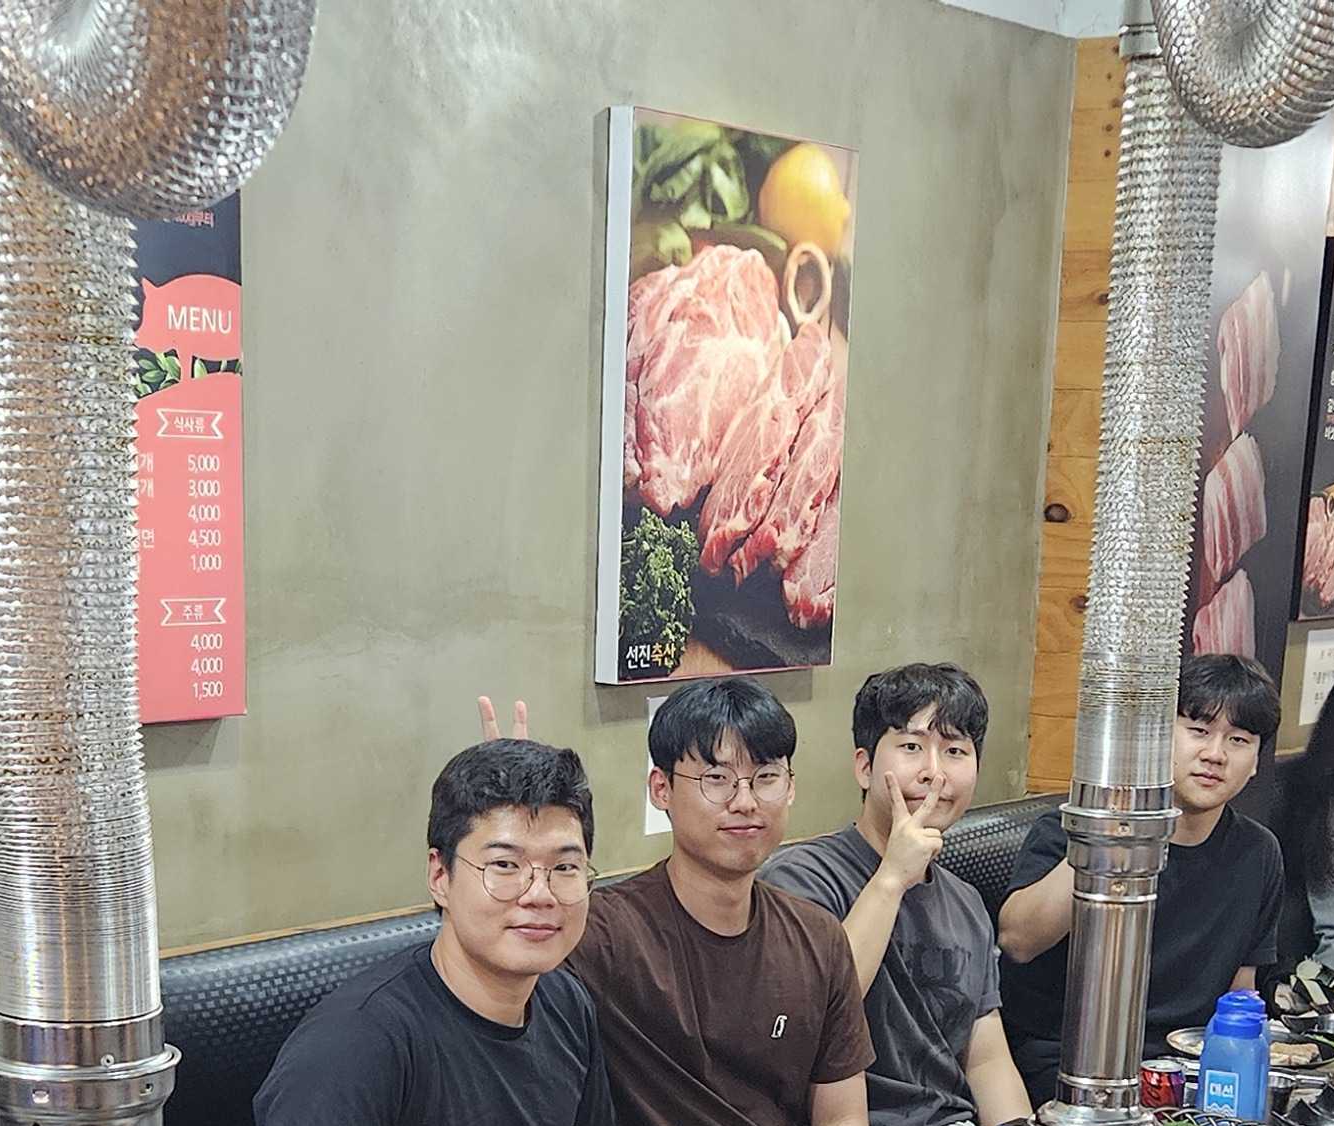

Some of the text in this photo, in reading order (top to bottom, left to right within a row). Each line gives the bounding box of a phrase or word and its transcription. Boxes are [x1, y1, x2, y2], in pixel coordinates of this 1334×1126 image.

[168, 304, 232, 334] MENU
[174, 416, 205, 433] 식사류
[188, 454, 220, 474] 5,000
[189, 479, 221, 498] 3,000
[188, 504, 221, 524] 4,000
[188, 529, 222, 549] 4,500
[190, 554, 222, 573] 1,000
[190, 633, 223, 653] 4,000
[626, 642, 676, 669] 선진축산
[190, 657, 223, 677] 4,000
[192, 681, 224, 701] 1,500
